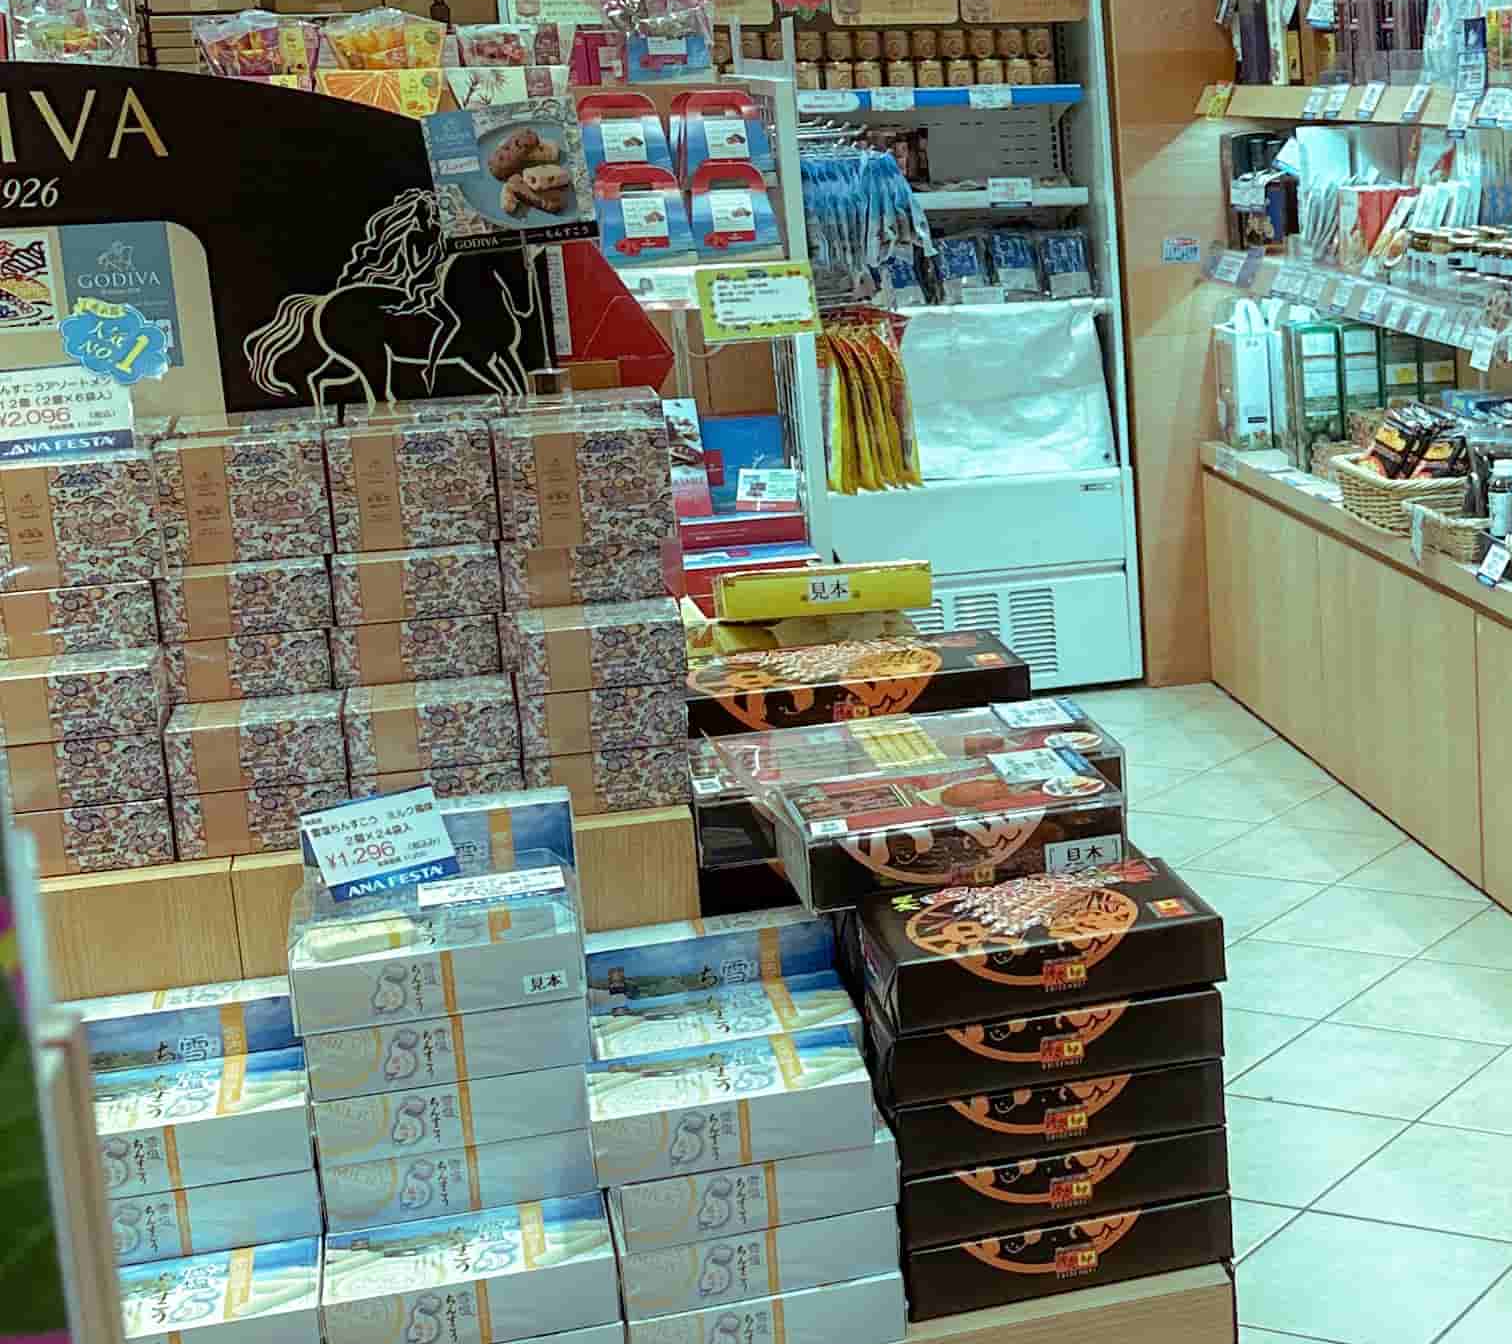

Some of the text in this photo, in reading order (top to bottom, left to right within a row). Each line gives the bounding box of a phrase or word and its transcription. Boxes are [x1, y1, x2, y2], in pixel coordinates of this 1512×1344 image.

[454, 236, 499, 251] GODIVA
[78, 270, 161, 290] GODIVA
[116, 334, 149, 373] 1
[11, 434, 118, 456] ANA FESTA
[809, 579, 850, 600] 見本
[326, 840, 397, 870] ¥1,296
[347, 879, 384, 898] ANA
[387, 863, 444, 888] FESTA
[529, 974, 562, 992] 見本
